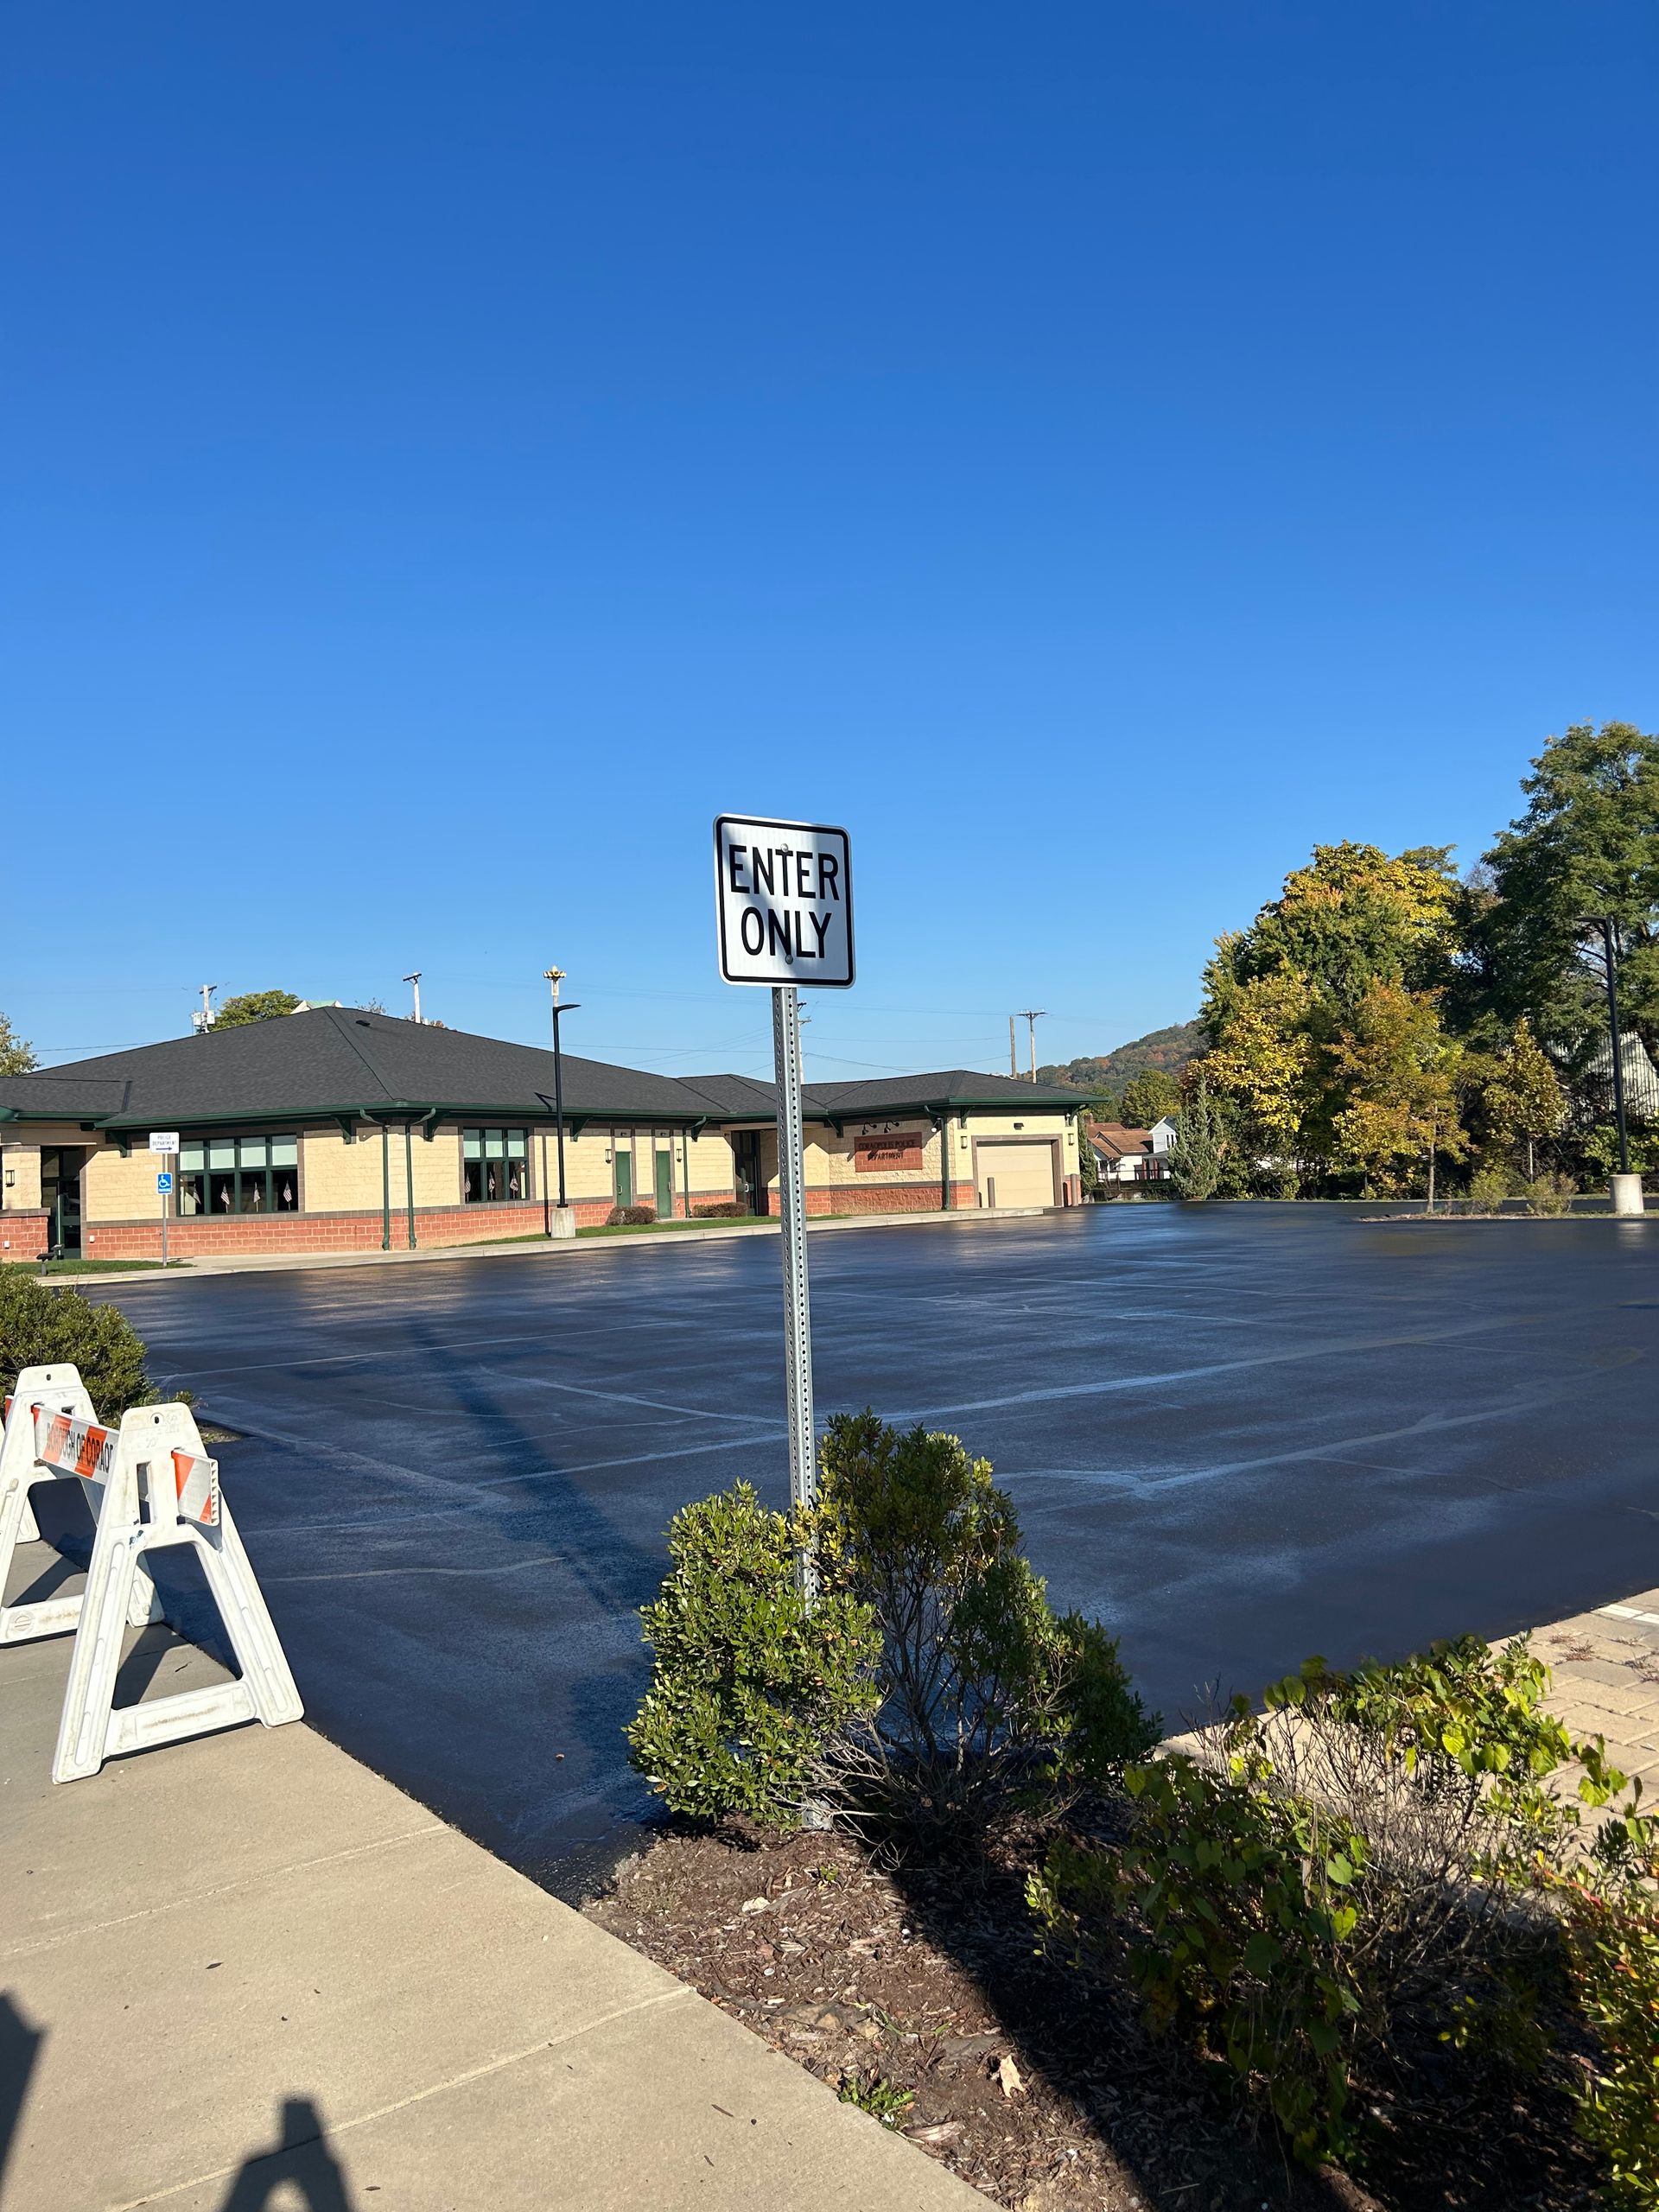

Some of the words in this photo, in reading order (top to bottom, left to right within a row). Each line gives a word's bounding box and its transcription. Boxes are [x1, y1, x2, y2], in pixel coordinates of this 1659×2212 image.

[728, 843, 840, 901] ENTER
[741, 906, 832, 959] ONLY
[868, 1151, 903, 1160] PARTMENT
[76, 1433, 86, 1462] OF
